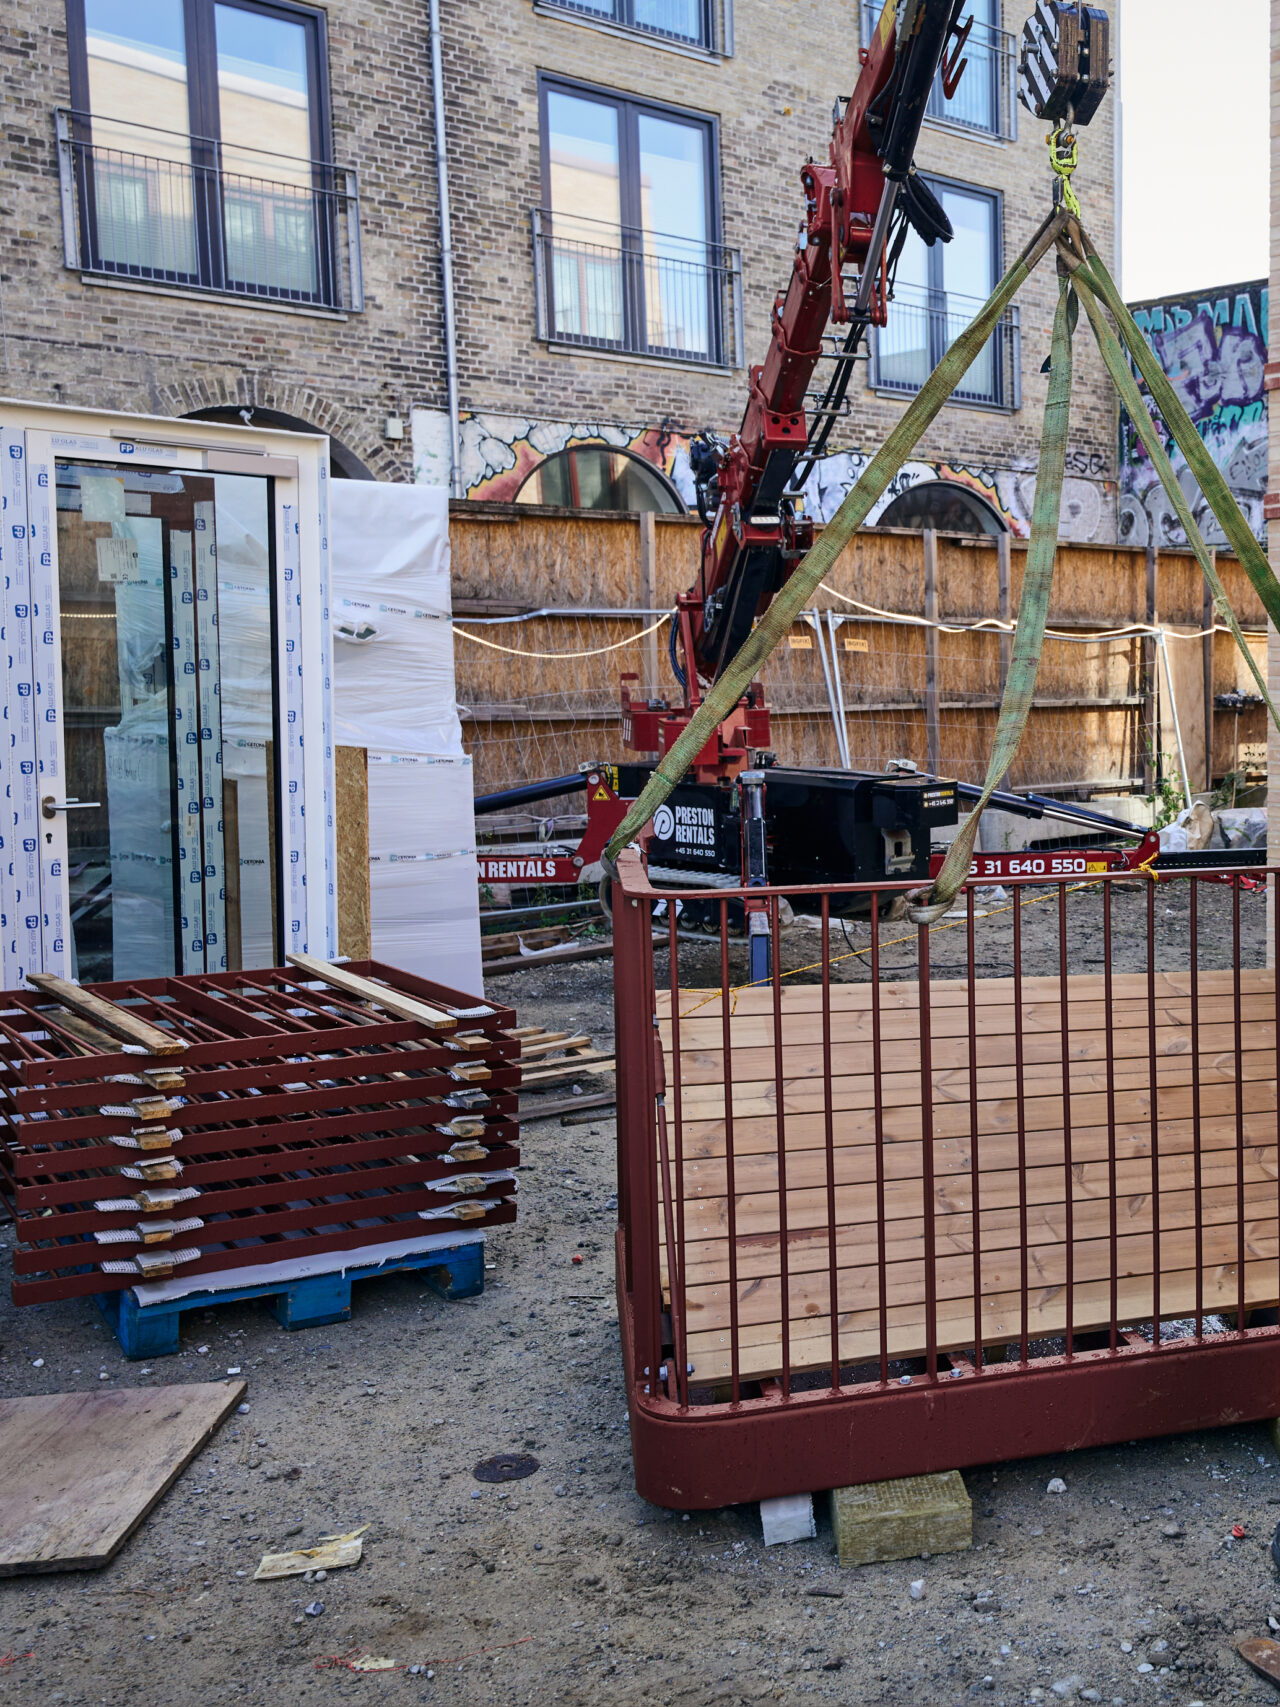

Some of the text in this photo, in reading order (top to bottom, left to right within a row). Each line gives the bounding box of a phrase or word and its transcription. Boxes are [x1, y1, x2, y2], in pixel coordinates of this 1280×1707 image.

[10, 446, 21, 458] FP
[121, 443, 133, 453] FP
[13, 526, 24, 538] FP
[182, 592, 192, 603] FP
[198, 589, 207, 600] FP
[16, 605, 27, 617] FP
[185, 663, 194, 673] FP
[200, 659, 209, 670] FP
[18, 684, 30, 695] FP
[187, 733, 196, 743] FP
[203, 729, 211, 739] FP
[21, 762, 32, 773] FP
[189, 803, 198, 813] FP
[204, 797, 213, 808] FP
[675, 806, 714, 826] PRESTON
[675, 825, 715, 845] RENTALS
[24, 840, 35, 851] FP
[206, 865, 215, 876] FP
[488, 861, 556, 878] RENTALS
[984, 860, 1001, 874] 31
[1009, 859, 1045, 874] 640
[1052, 858, 1086, 872] 550
[191, 872, 200, 882] FP
[26, 916, 38, 928] FP
[207, 934, 216, 944] FP
[193, 941, 202, 951] FP
